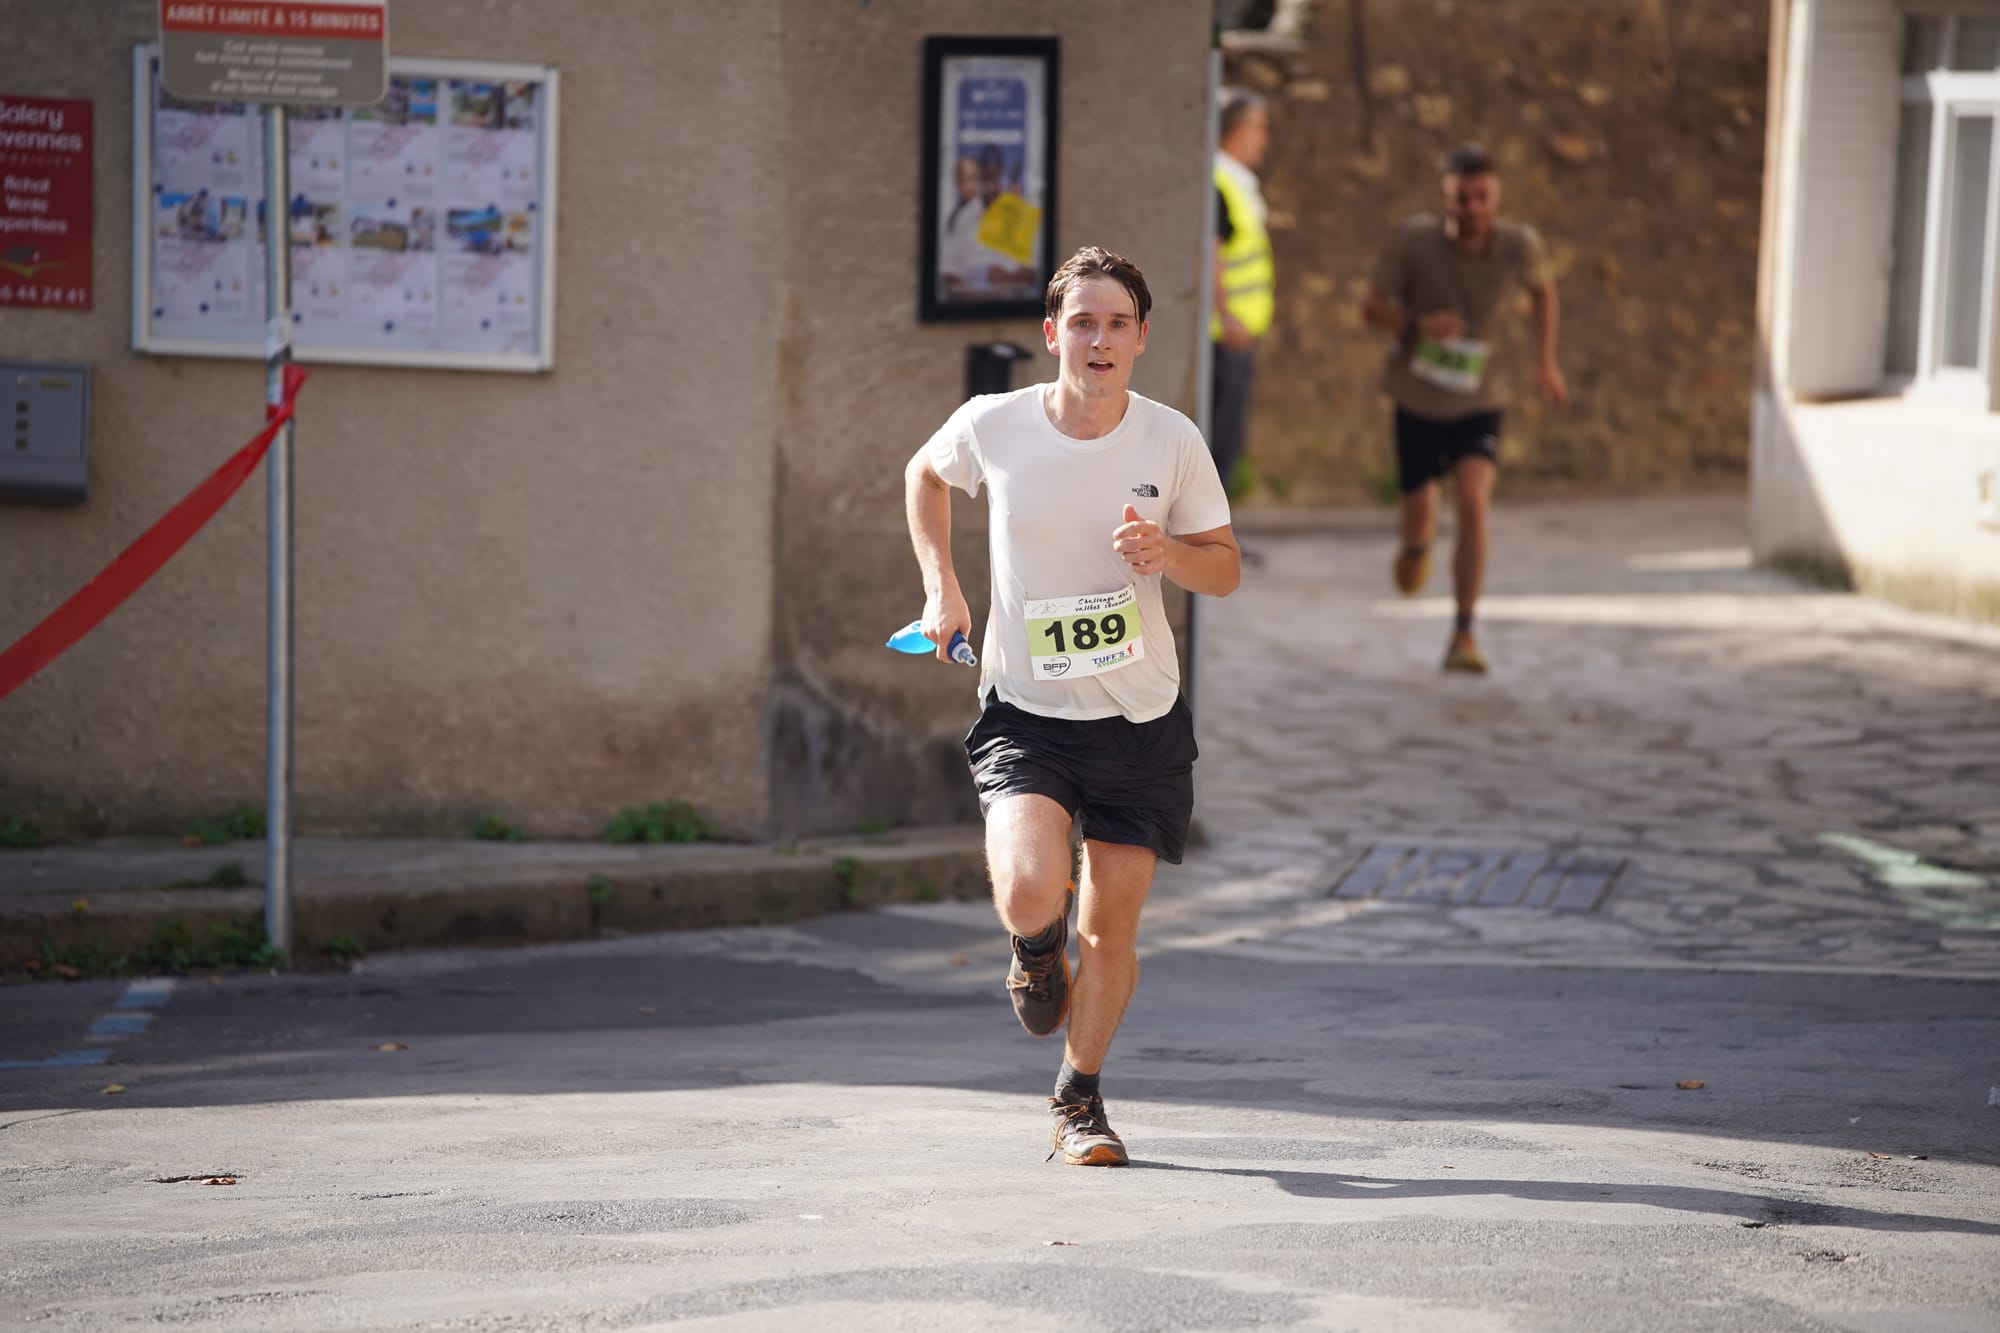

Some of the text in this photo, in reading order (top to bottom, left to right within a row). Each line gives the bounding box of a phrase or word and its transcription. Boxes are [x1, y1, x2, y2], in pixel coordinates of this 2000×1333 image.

[166, 3, 380, 32] ARRÊT LIMITÉ À 15 MINUTES
[6, 194, 49, 213] Vente
[1078, 596, 1114, 605] Challenge
[1044, 613, 1126, 652] 189
[1092, 650, 1125, 665] TUFF'S
